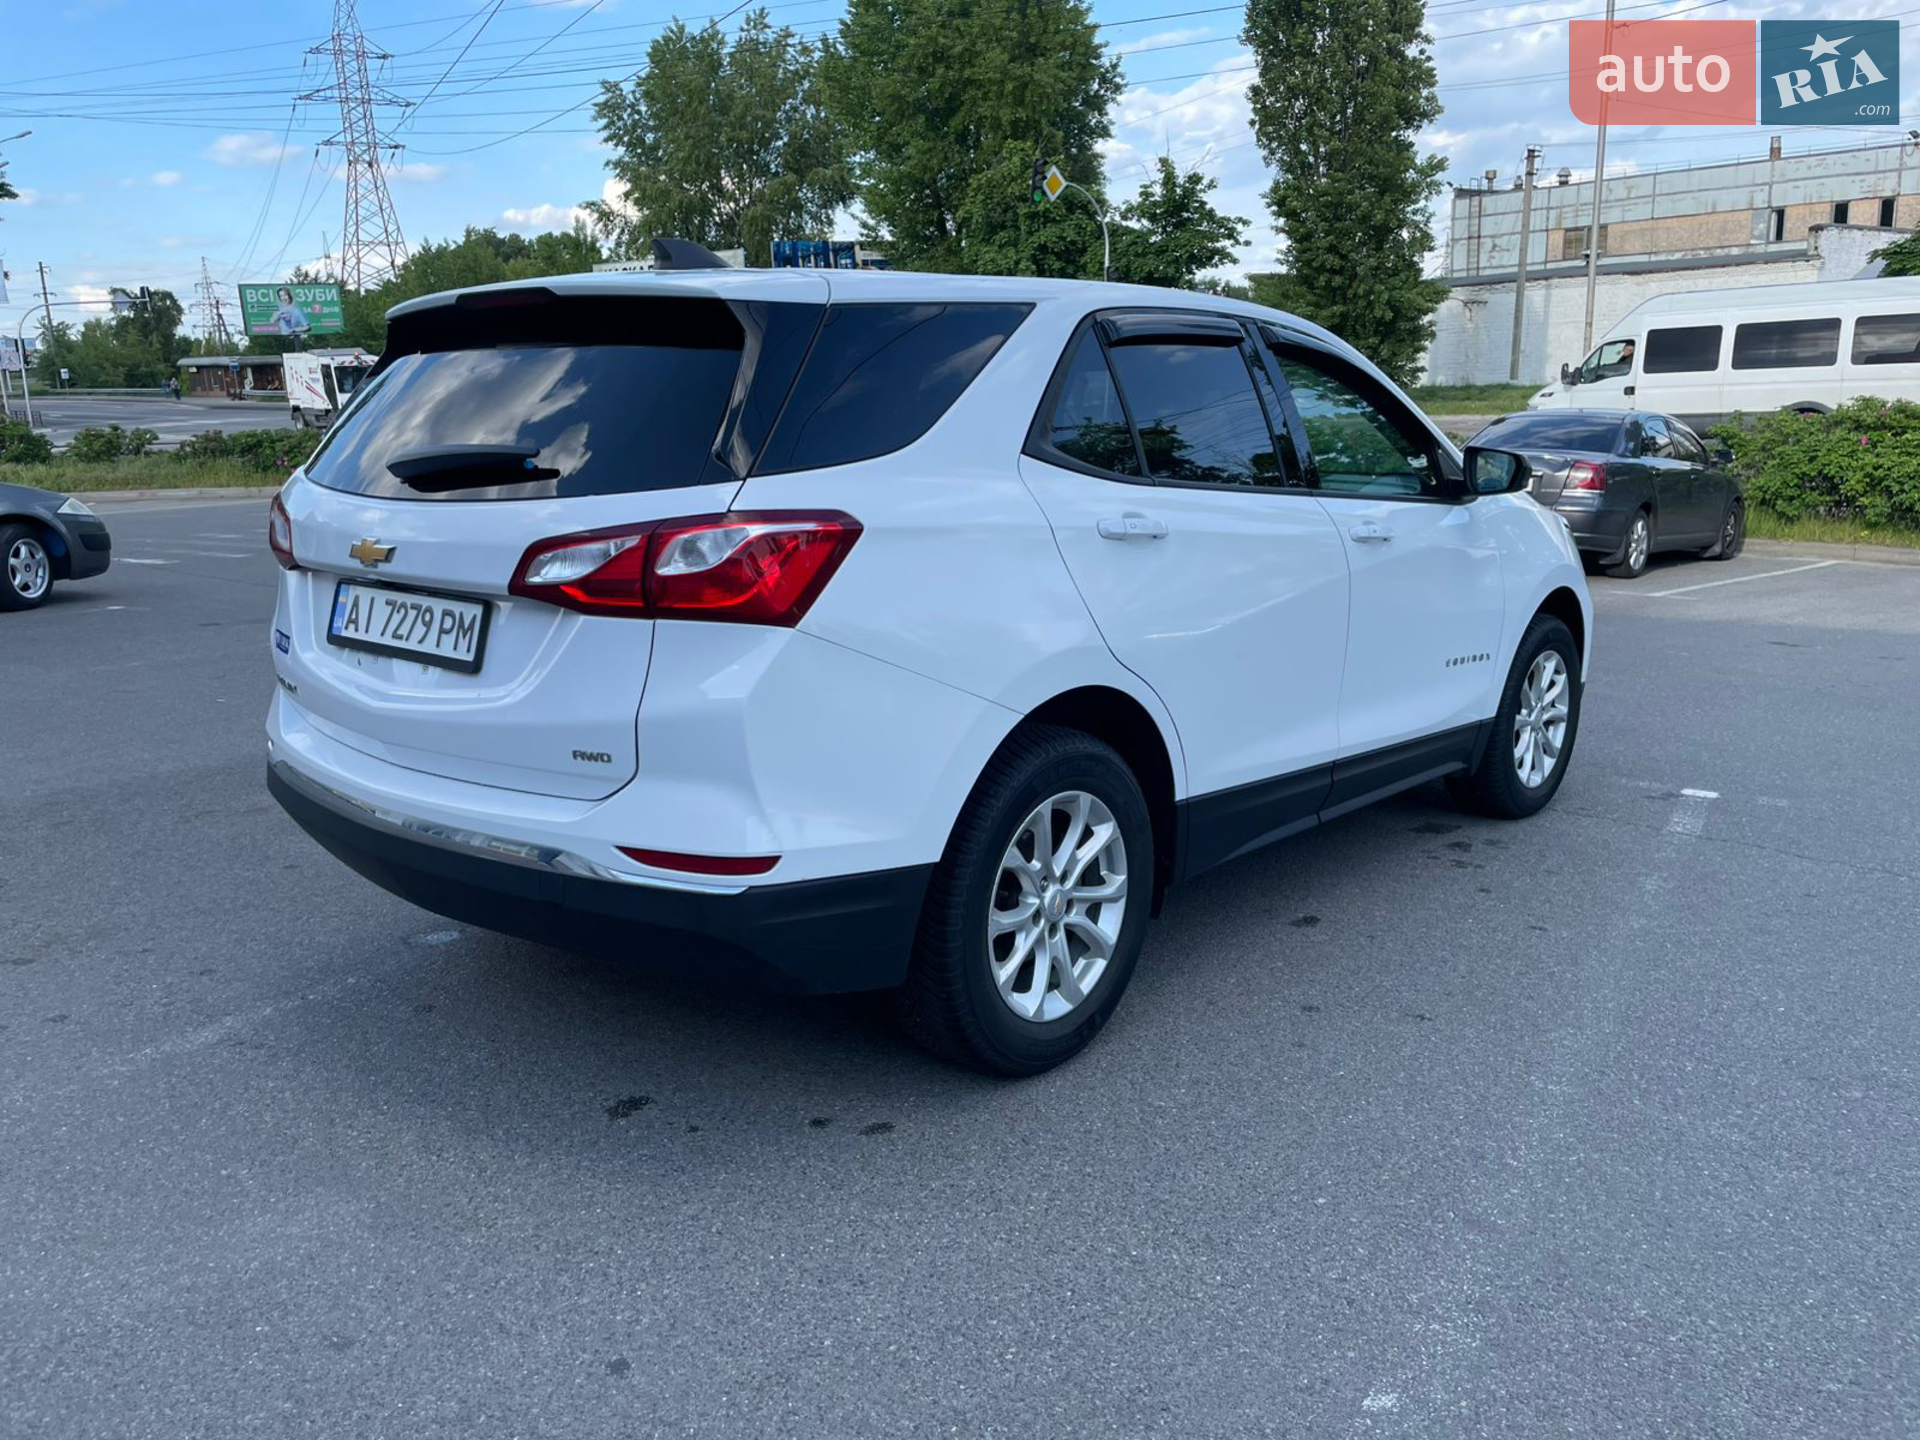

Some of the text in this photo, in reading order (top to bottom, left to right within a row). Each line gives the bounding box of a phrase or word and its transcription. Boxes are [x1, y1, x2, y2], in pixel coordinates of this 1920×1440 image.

[245, 288, 338, 303] ВСІ ЗУБИ
[344, 594, 477, 654] AI 7279 PM
[571, 749, 613, 764] AWD
